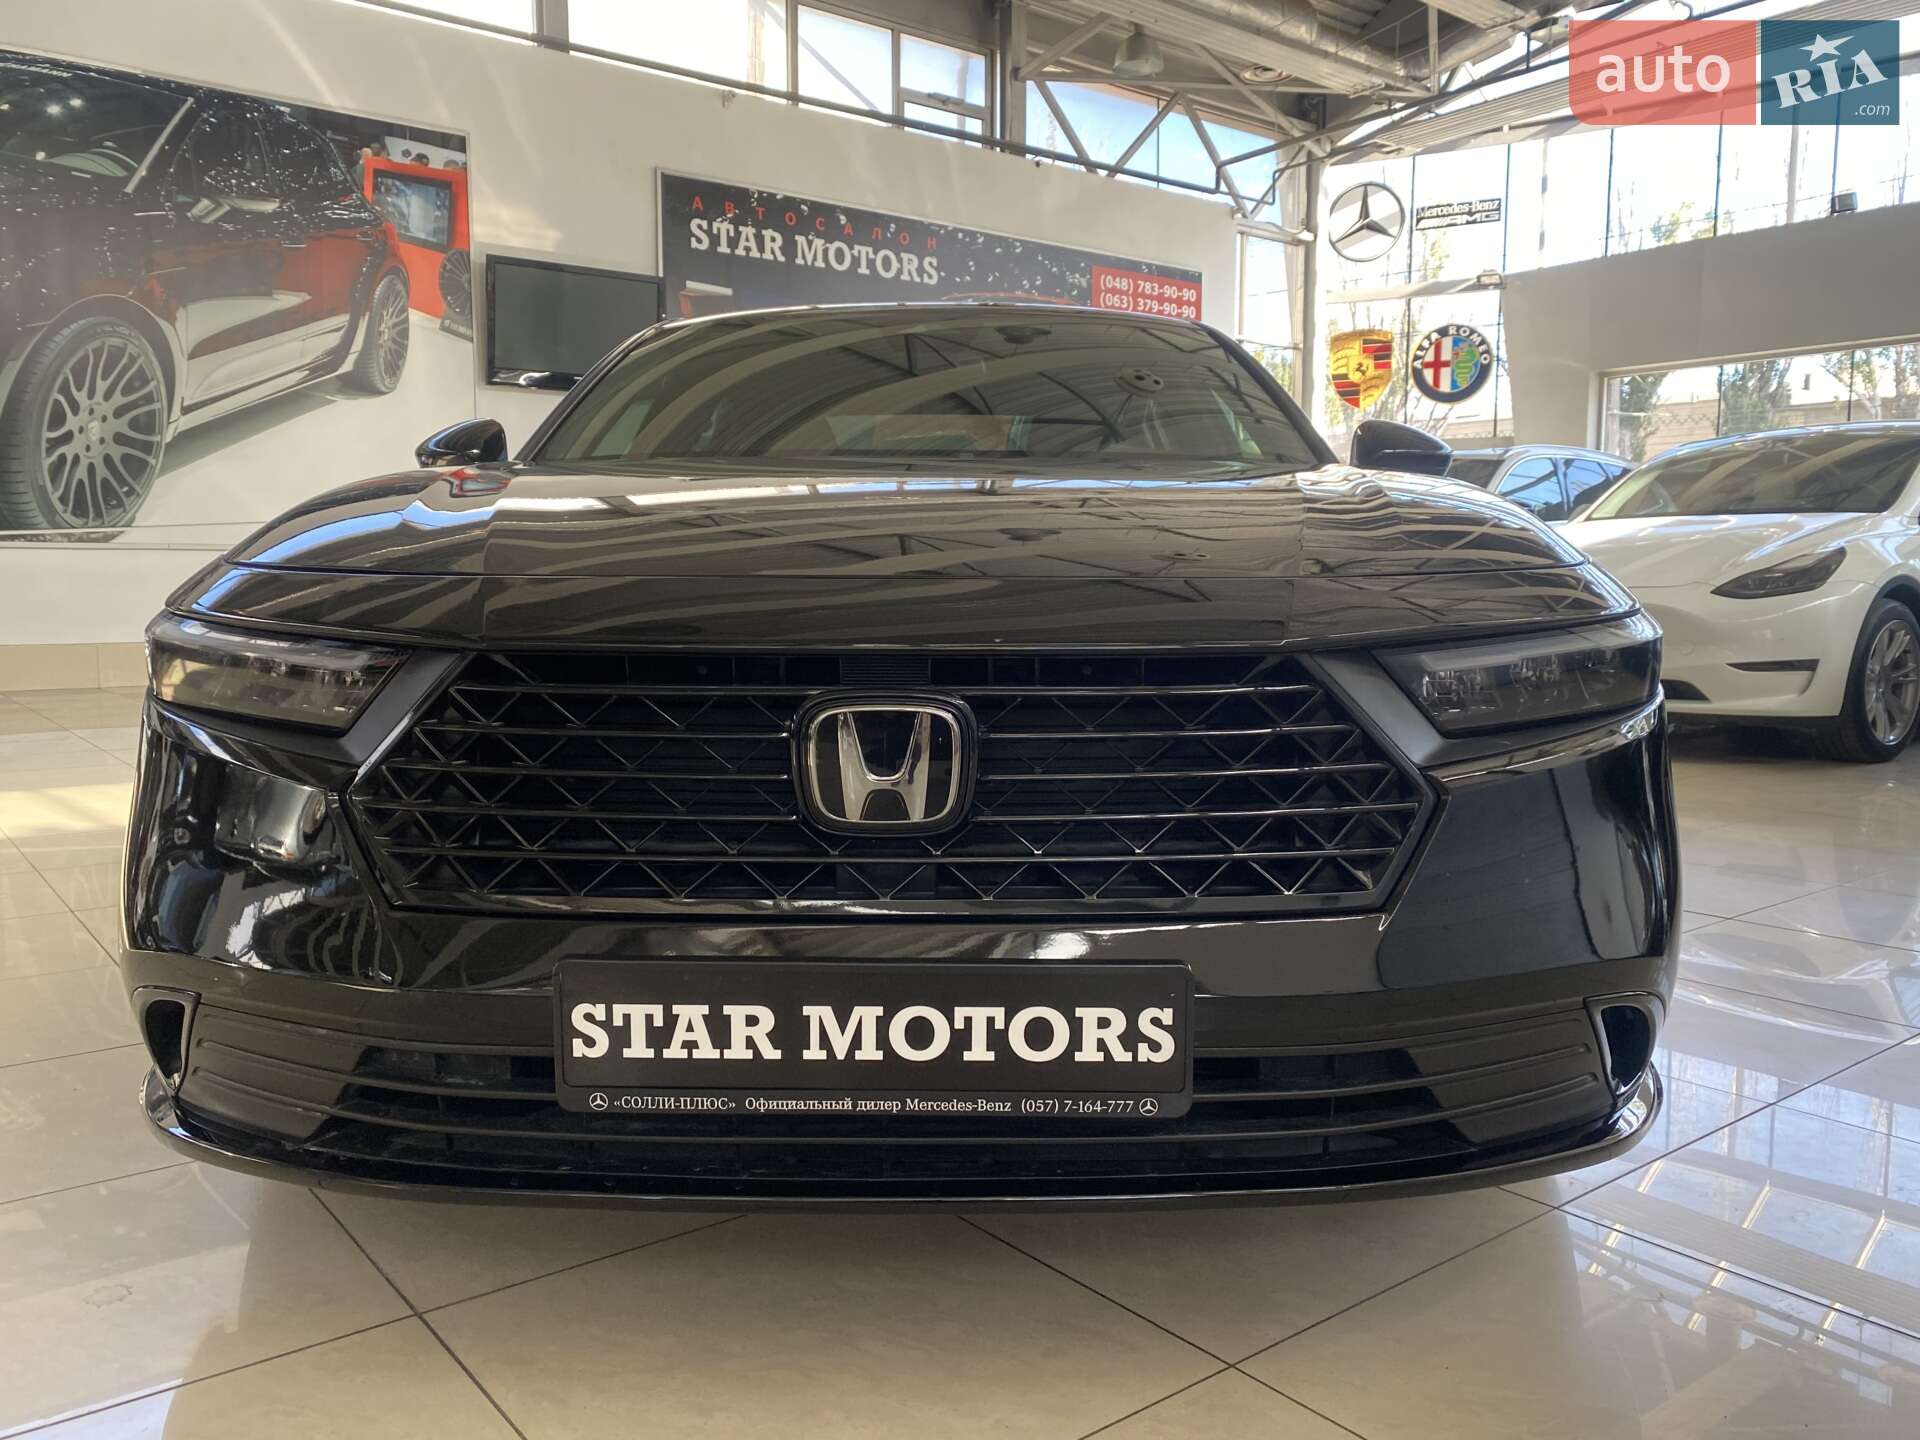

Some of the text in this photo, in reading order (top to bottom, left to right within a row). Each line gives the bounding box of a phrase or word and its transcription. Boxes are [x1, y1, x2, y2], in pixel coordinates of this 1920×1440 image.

[691, 195, 938, 251] АВТОСАЛОН
[1417, 200, 1500, 218] Mercedes-Benz
[690, 218, 940, 287] STAR MOTORS
[1099, 273, 1197, 303] (048) 783-90-90
[1099, 291, 1197, 319] (063) 379-90-90
[1413, 325, 1491, 370] ALFA ROMEO
[570, 1002, 1175, 1063] STAR MOTORS
[613, 1095, 1135, 1115] «СОЛЛИ-ПЛЮС» Официальный дилер Mercedes-Benz (057) 7-164-777
